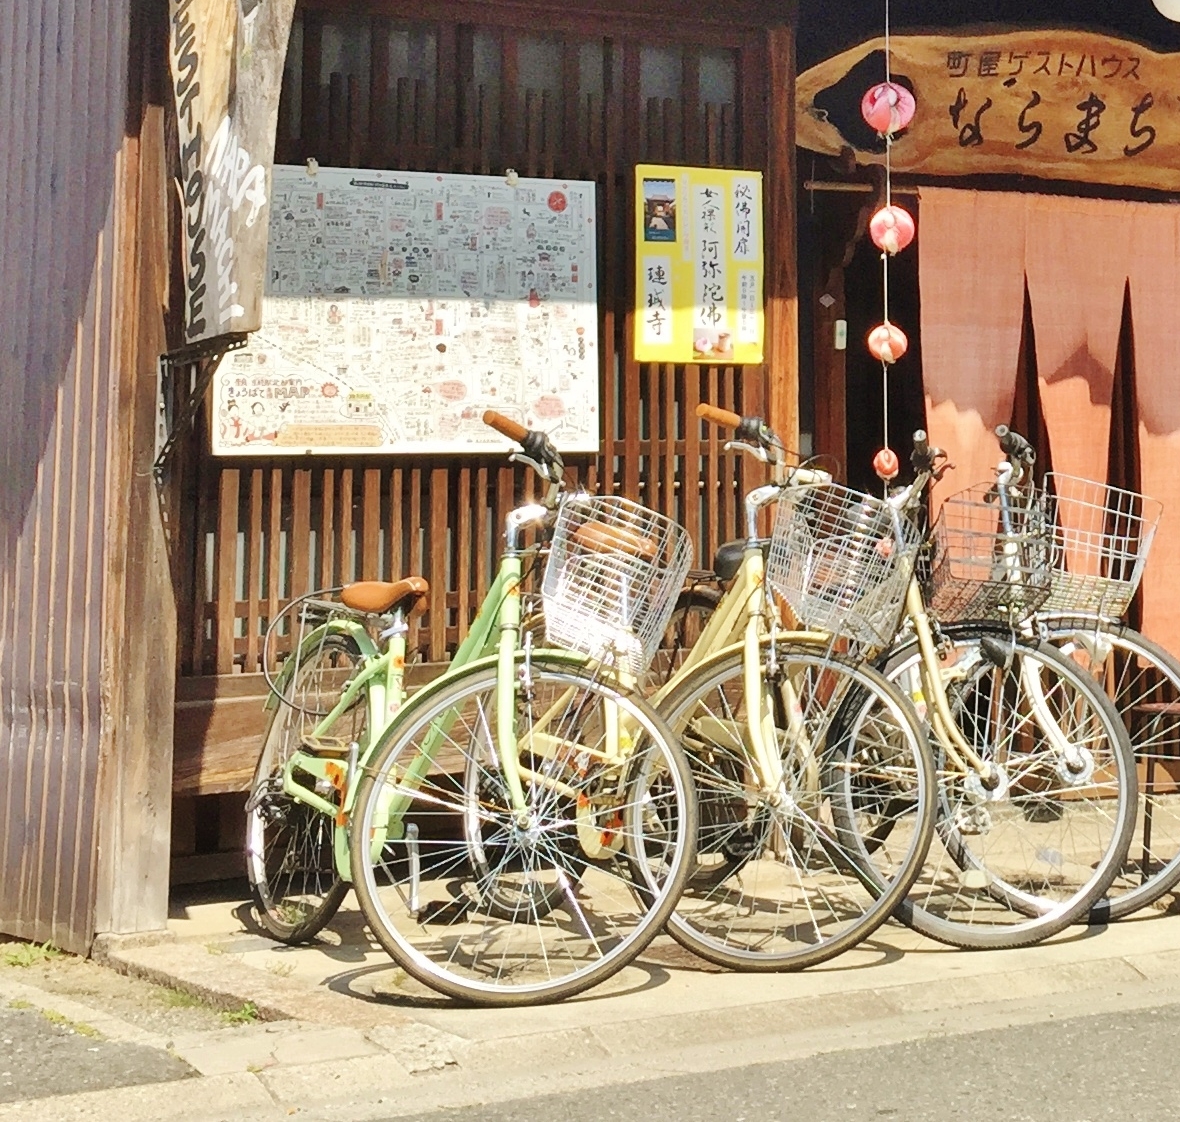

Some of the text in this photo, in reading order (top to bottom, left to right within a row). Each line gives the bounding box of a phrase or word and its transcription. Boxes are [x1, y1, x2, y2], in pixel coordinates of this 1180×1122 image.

[945, 50, 1142, 81] 町屋ゲストハウス
[948, 87, 1157, 157] ならまち
